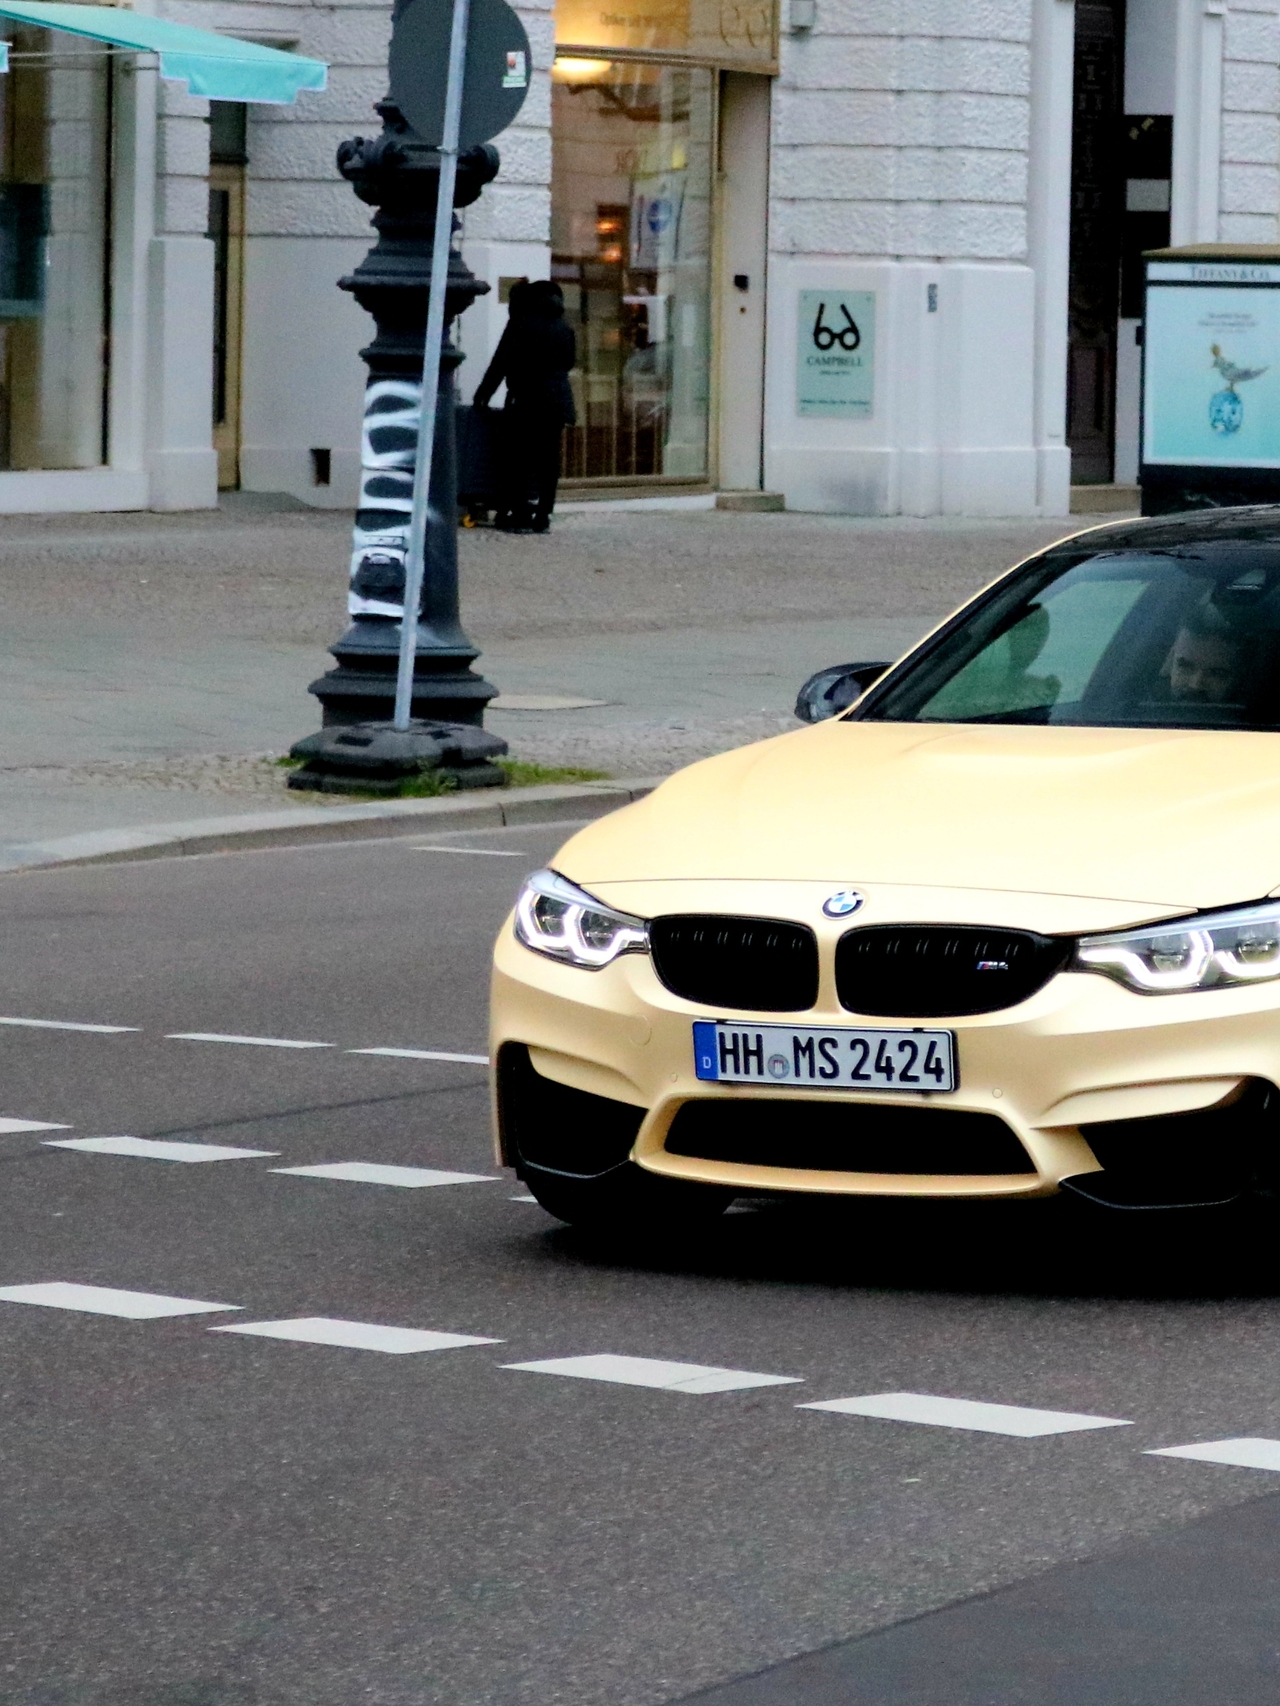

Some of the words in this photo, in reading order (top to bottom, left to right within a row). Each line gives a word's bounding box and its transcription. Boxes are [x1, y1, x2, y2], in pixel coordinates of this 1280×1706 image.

[806, 356, 863, 368] CAMPBELL
[718, 1031, 765, 1076] HH
[792, 1035, 841, 1080] MS
[850, 1038, 945, 1083] 2424
